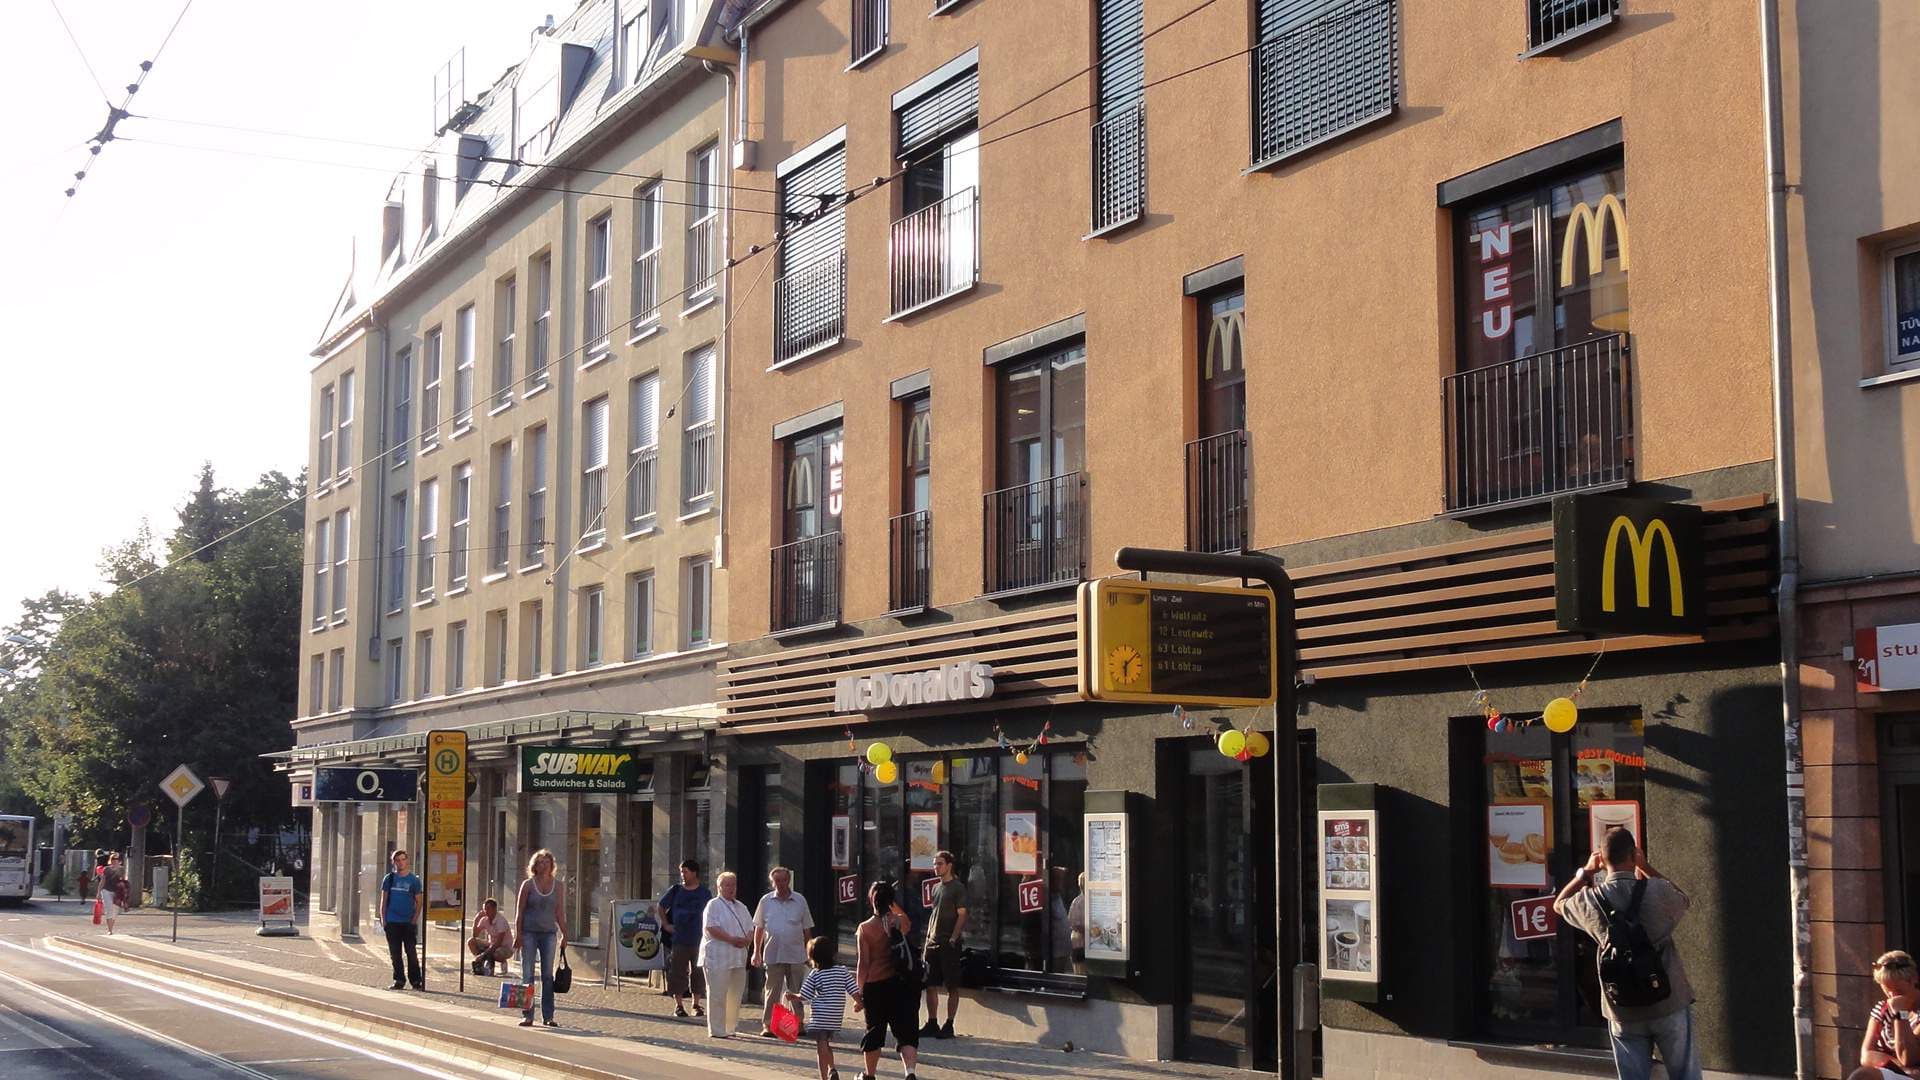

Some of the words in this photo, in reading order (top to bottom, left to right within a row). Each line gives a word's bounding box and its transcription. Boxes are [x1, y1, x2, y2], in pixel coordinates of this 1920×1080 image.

[1481, 223, 1511, 339] NEU
[829, 440, 843, 515] NEU
[834, 660, 994, 712] McDonald's
[530, 752, 631, 776] SUBWAY
[533, 778, 586, 788] Sandwiches
[588, 779, 595, 788] &
[597, 779, 626, 788] Salads
[841, 881, 854, 898] 1€
[1022, 887, 1039, 906] 1€
[1518, 906, 1549, 932] 1€
